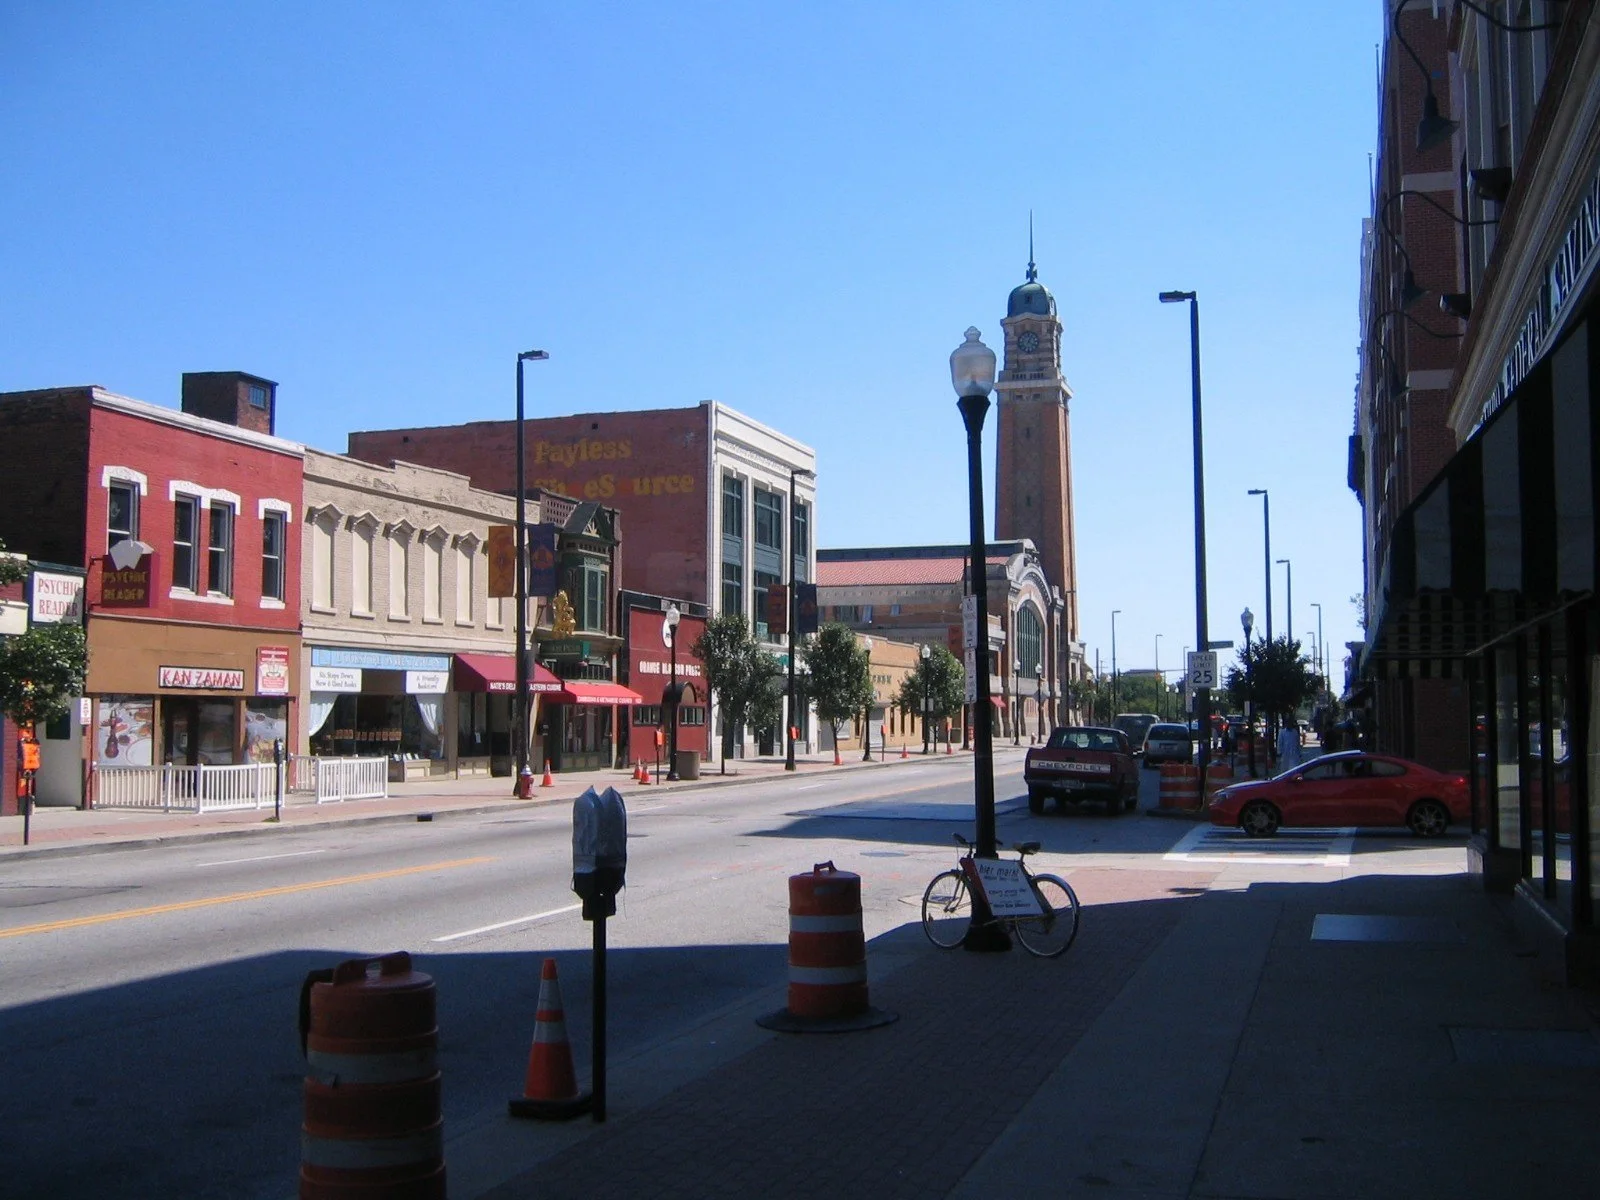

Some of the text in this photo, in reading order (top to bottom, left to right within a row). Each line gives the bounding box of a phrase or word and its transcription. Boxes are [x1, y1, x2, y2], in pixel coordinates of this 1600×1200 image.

[1502, 263, 1551, 399] FEDERAL
[1550, 168, 1600, 325] SAVIN
[534, 438, 632, 468] Payless
[38, 579, 80, 596] PSYCHIC
[39, 599, 78, 617] READER
[162, 669, 241, 687] KAN ZAMAN
[1193, 670, 1213, 684] 25
[1038, 761, 1101, 772] CHEVROLET
